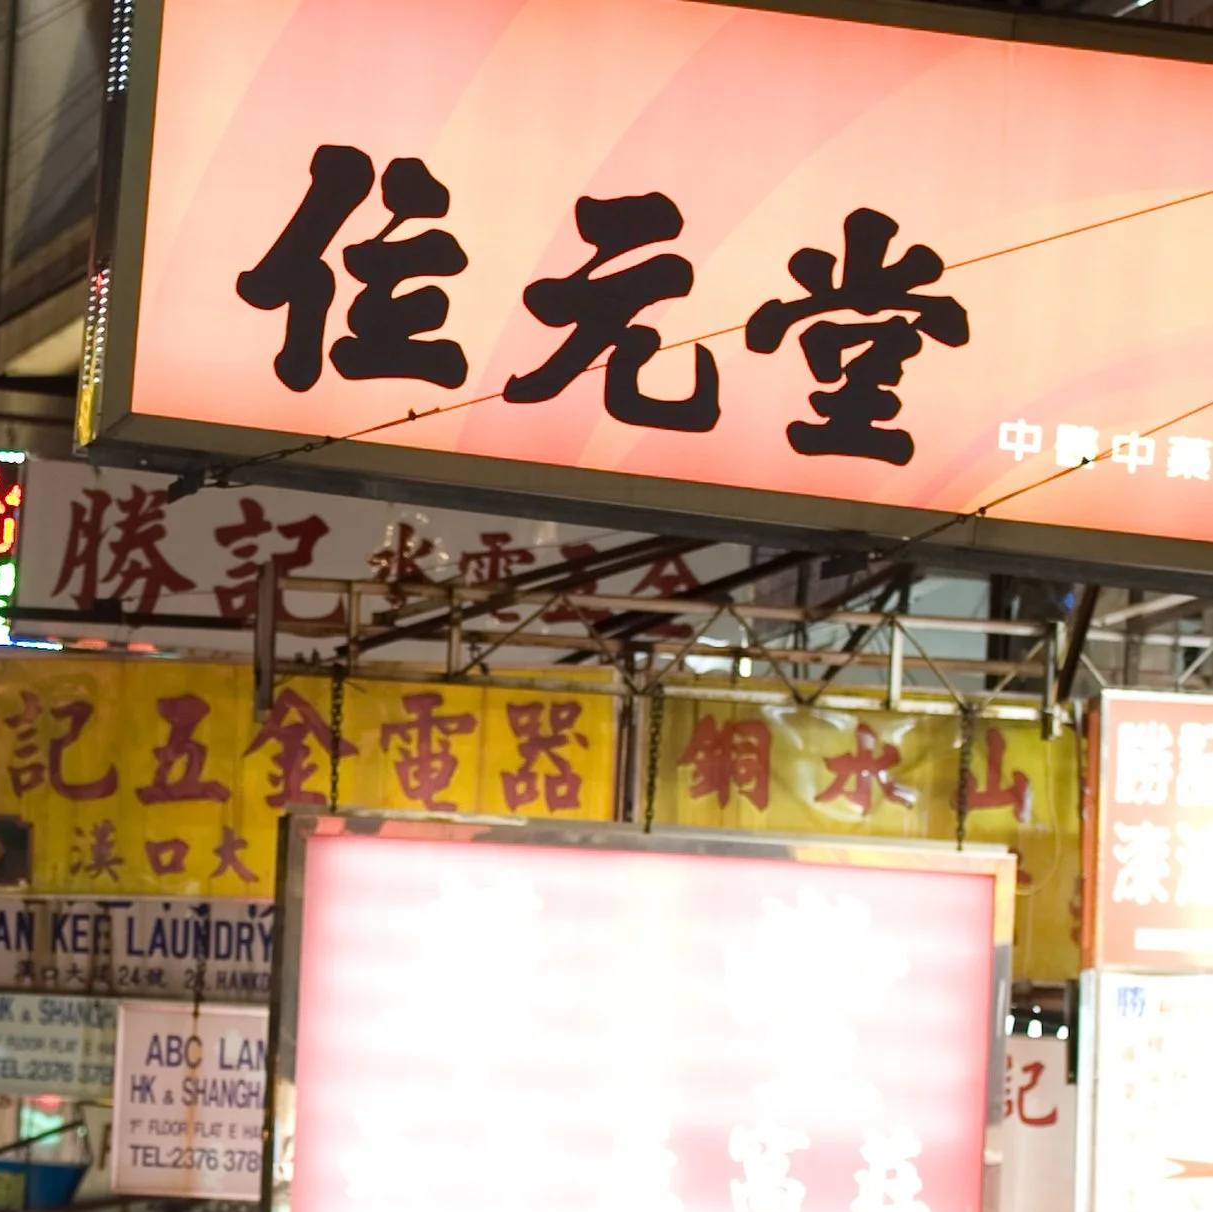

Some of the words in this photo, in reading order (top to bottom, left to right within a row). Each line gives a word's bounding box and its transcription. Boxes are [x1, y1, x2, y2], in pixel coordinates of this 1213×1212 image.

[236, 144, 970, 466] 位元堂
[49, 912, 112, 956] KEE
[126, 915, 275, 964] LAUNDRY
[145, 1034, 203, 1069] ABC
[130, 1074, 156, 1104] HK
